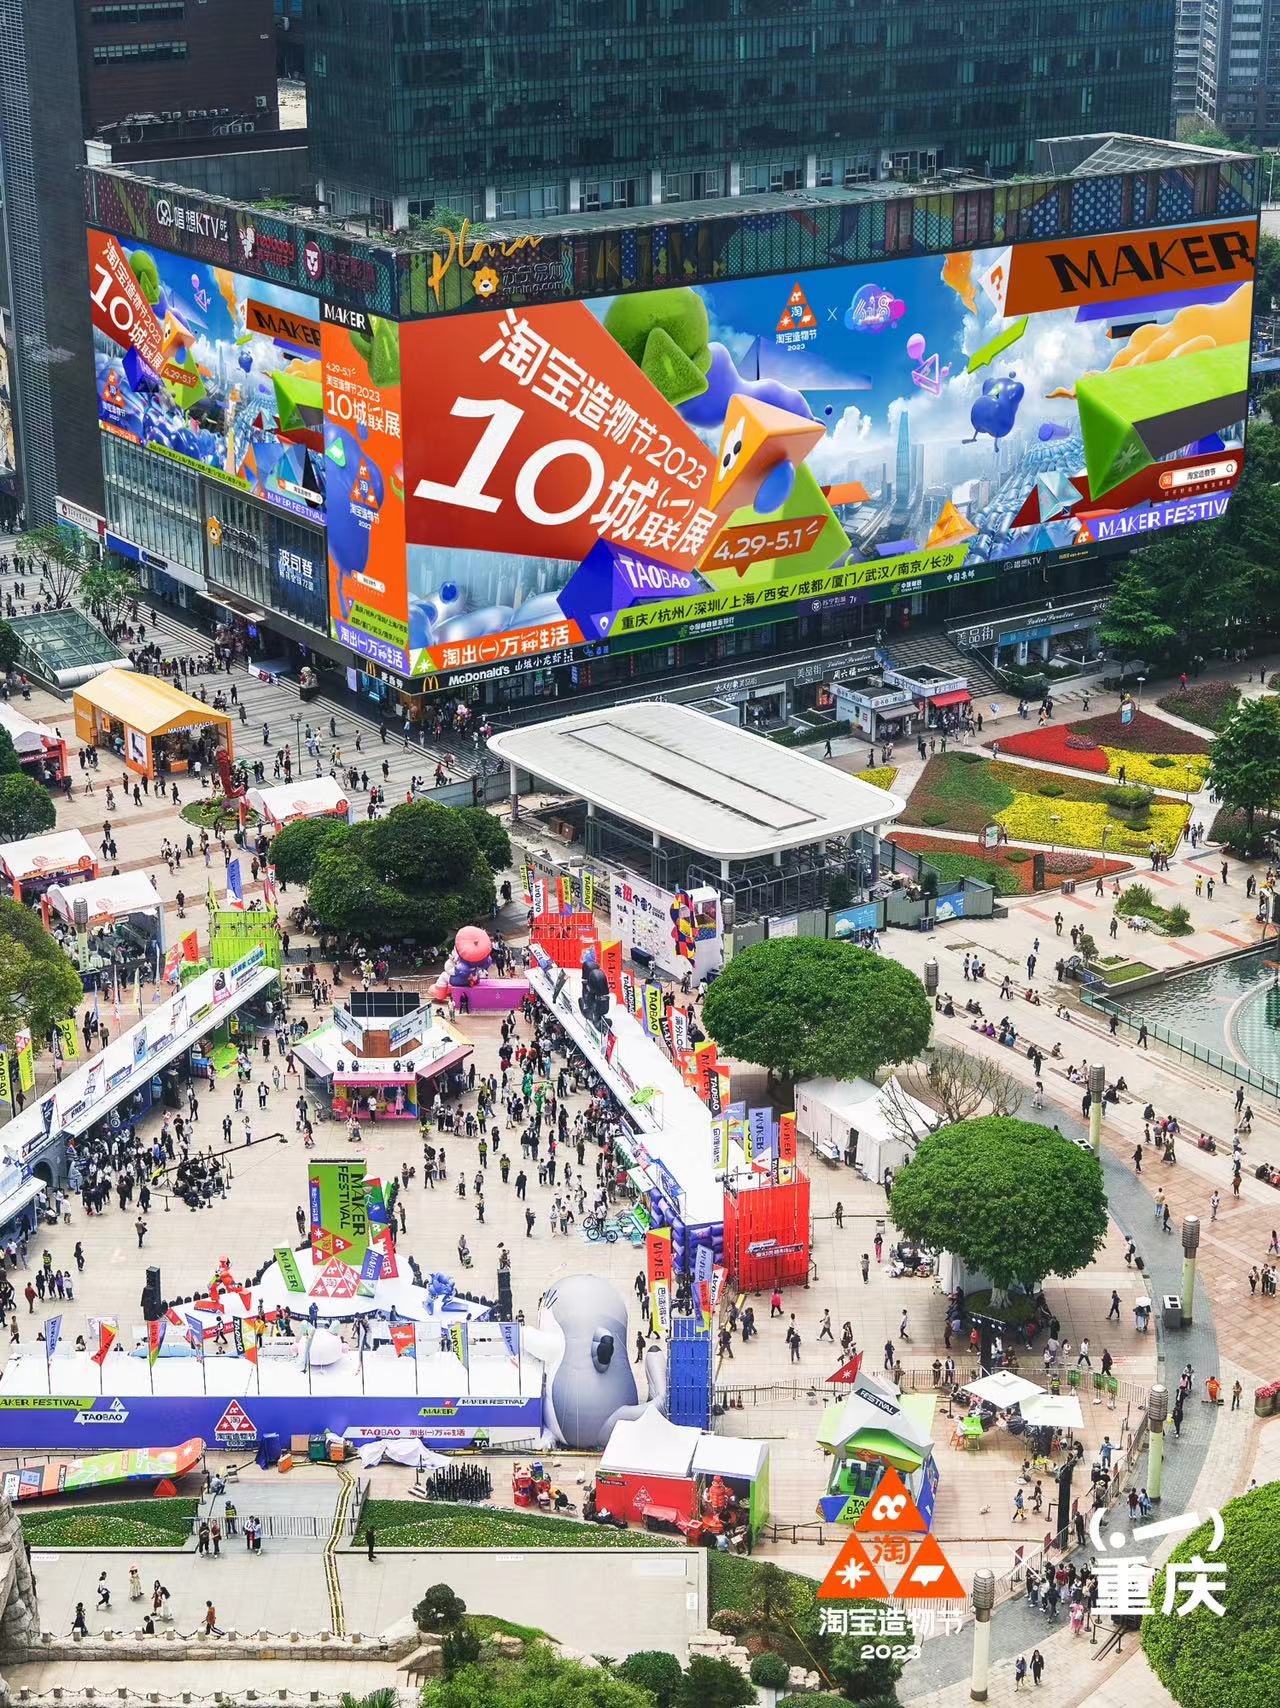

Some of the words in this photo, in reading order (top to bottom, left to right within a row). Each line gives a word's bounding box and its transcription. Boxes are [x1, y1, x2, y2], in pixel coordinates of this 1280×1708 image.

[1045, 230, 1256, 293] MAKER
[324, 303, 366, 330] MAKER
[478, 308, 708, 490] 淘宝造物节2023
[292, 500, 325, 522] FESTIVAL
[1099, 510, 1161, 539] MAKER
[712, 528, 803, 561] 4.29-5.1
[619, 555, 691, 590] TAOBAO
[620, 552, 956, 632] 重庆/杭州/深圳/上海/西安/成都/厦门/武汉/南京/长沙
[448, 665, 511, 687] McDonald's
[607, 952, 616, 990] MAKER
[649, 990, 659, 1031] TAOBAO
[62, 1023, 75, 1055] 2023
[710, 1076, 720, 1111] TAOBAO
[338, 1165, 350, 1229] FESTIVAL
[351, 1172, 366, 1237] MAKER
[279, 1251, 299, 1289] MAKER
[365, 1250, 379, 1279] MAKER
[233, 1318, 244, 1352] TAOBAO
[0, 1398, 30, 1407] AKER
[33, 1398, 83, 1407] FESTIVAL
[82, 1413, 123, 1421] TAOBAO
[423, 1408, 454, 1416] MAKER
[859, 1390, 895, 1415] FESTIVAL
[360, 1428, 401, 1437] TAOBAO
